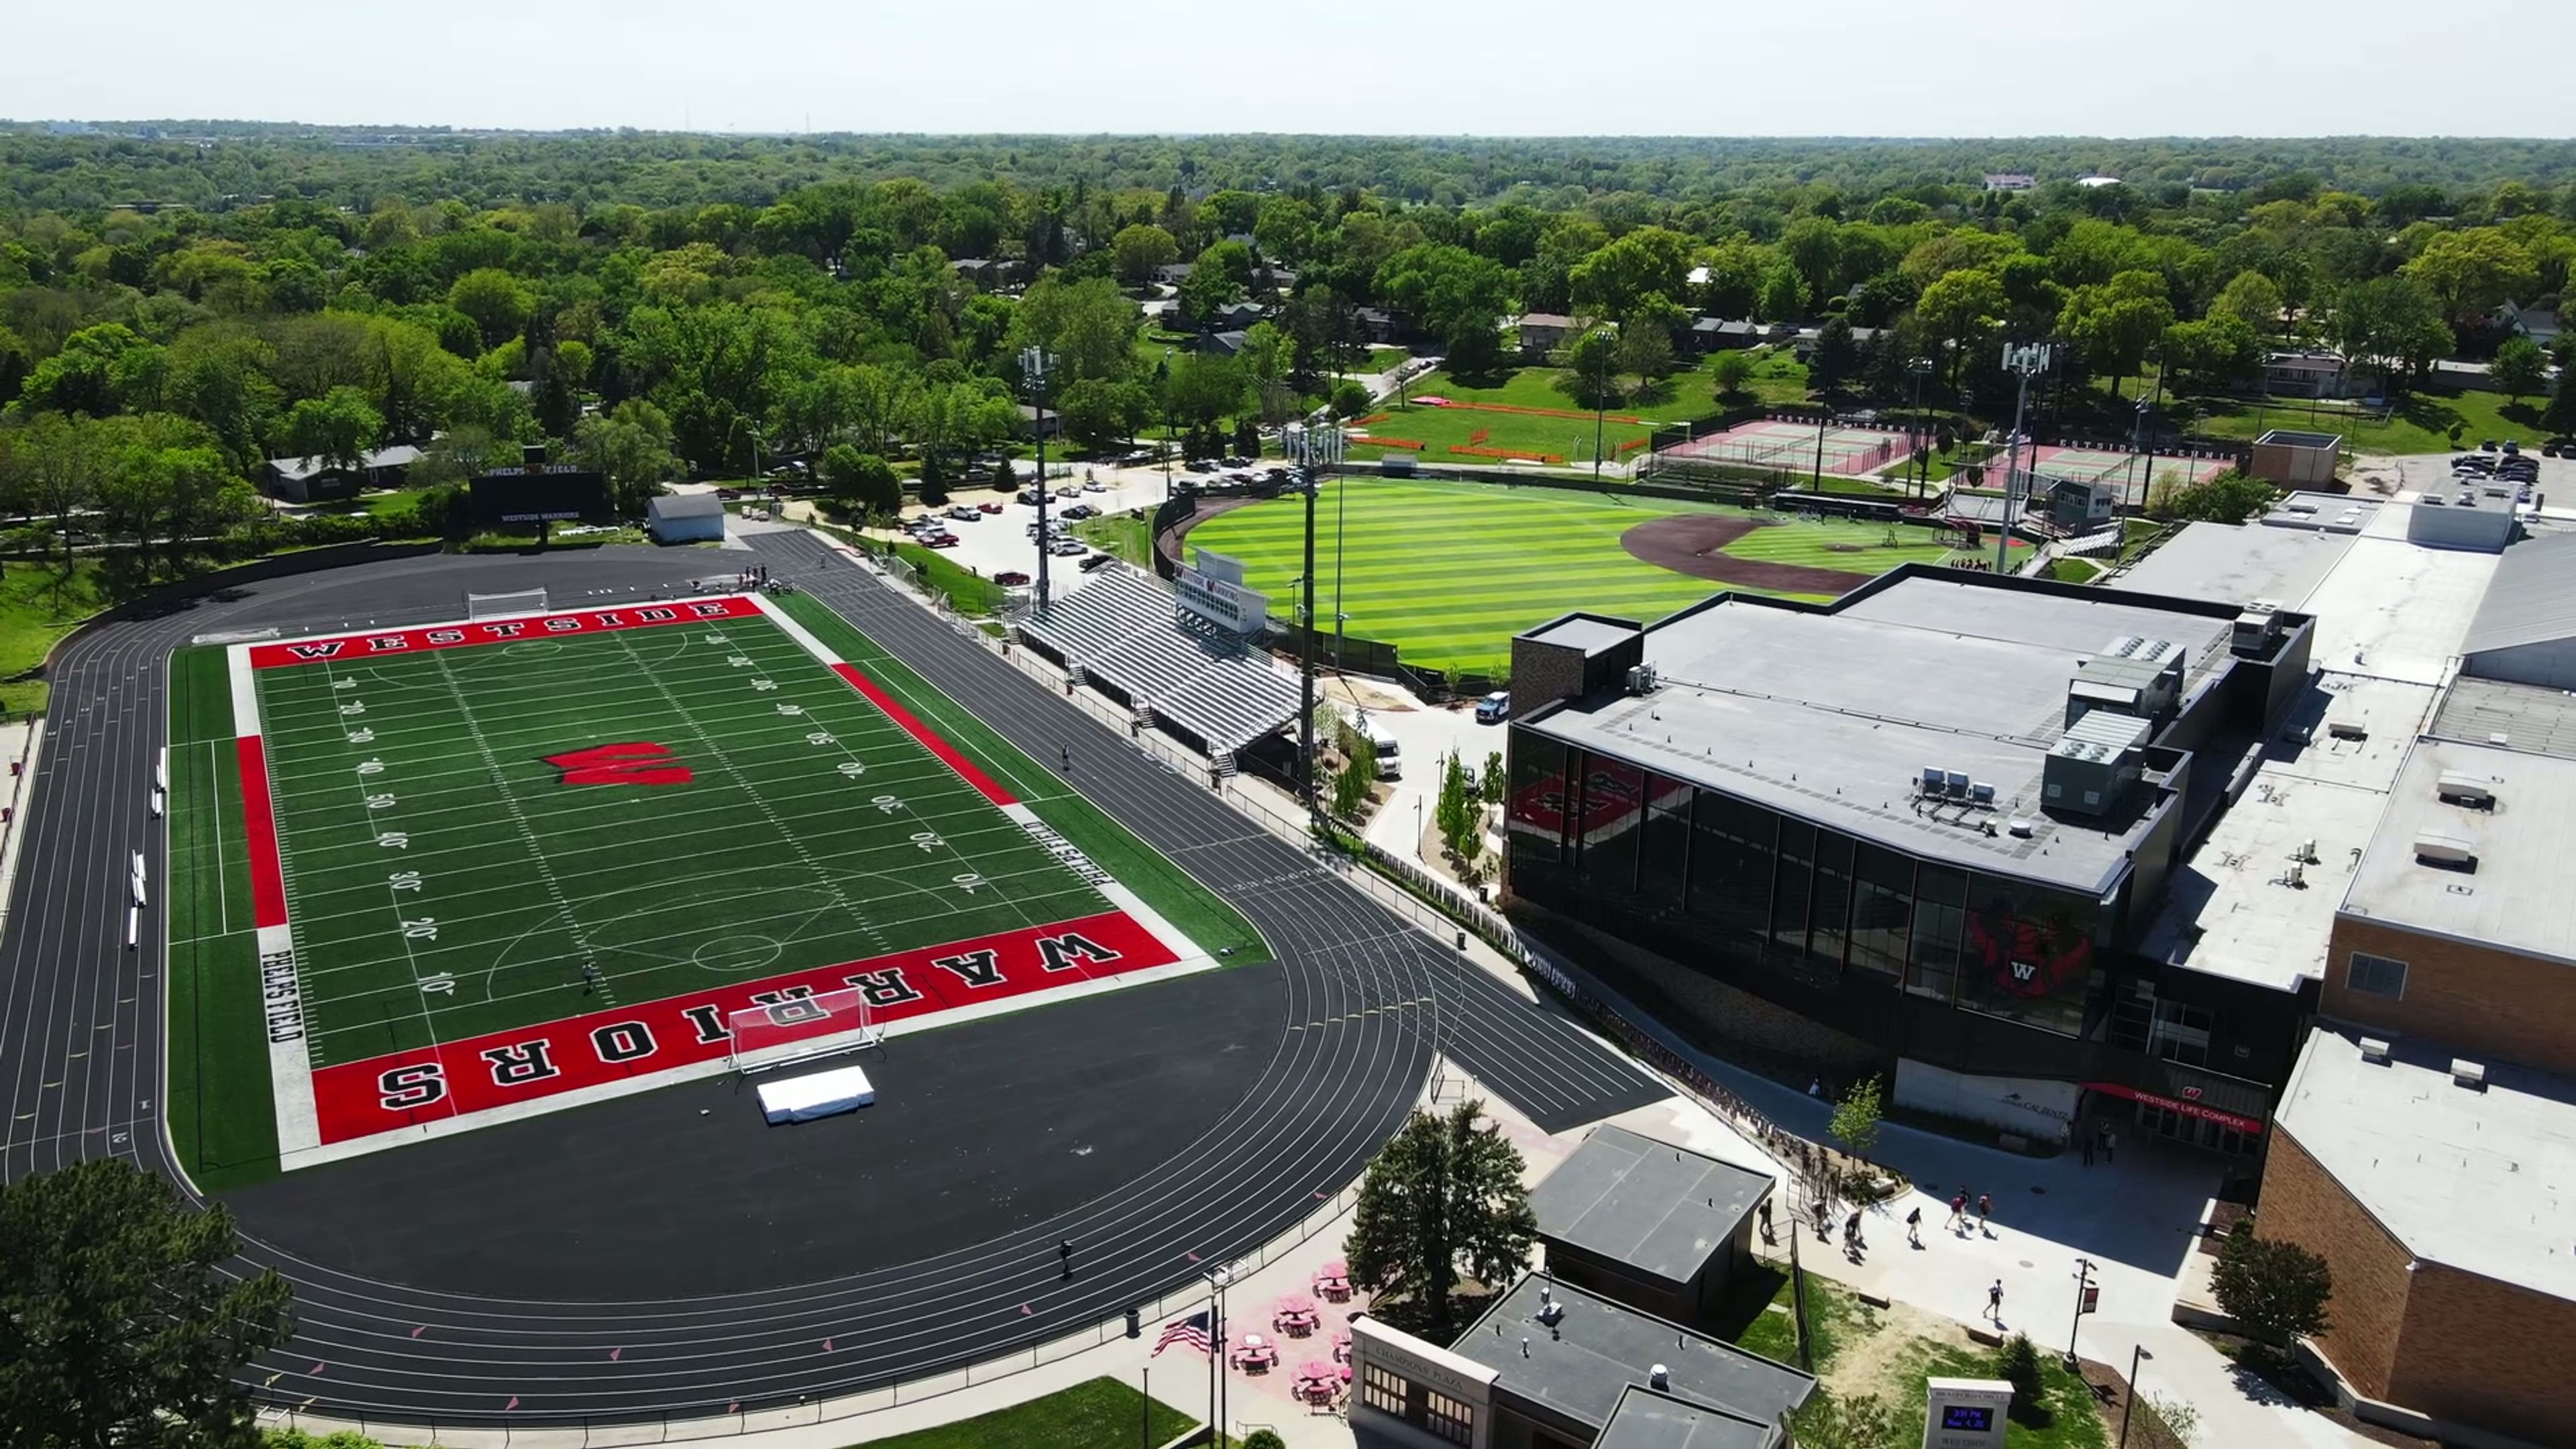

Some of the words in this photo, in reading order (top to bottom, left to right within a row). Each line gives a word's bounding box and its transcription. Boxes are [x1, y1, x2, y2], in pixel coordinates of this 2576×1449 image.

[489, 467, 525, 477] PHELPS
[546, 465, 577, 474] FIELD
[502, 514, 539, 522] WESTSIDE
[287, 601, 730, 660] WESTSIDE
[871, 796, 903, 810] 30
[910, 832, 944, 848] 20
[1022, 821, 1068, 850] FIELD
[1055, 848, 1116, 887] PHELPS
[388, 871, 423, 889] 30
[952, 873, 987, 889] 10
[402, 918, 438, 938] 20
[262, 950, 297, 1000] PHELPS
[418, 971, 455, 992] 10
[2010, 961, 2036, 981] W
[267, 1000, 303, 1043] FIELD
[378, 932, 1123, 1112] WARRIORS
[2135, 1091, 2180, 1110] WESTSIDE
[2181, 1104, 2200, 1116] LIFE
[2202, 1110, 2245, 1128] COMPLEX
[1376, 1347, 1428, 1375] CHAMPIONS
[1434, 1371, 1462, 1390] PLAZA
